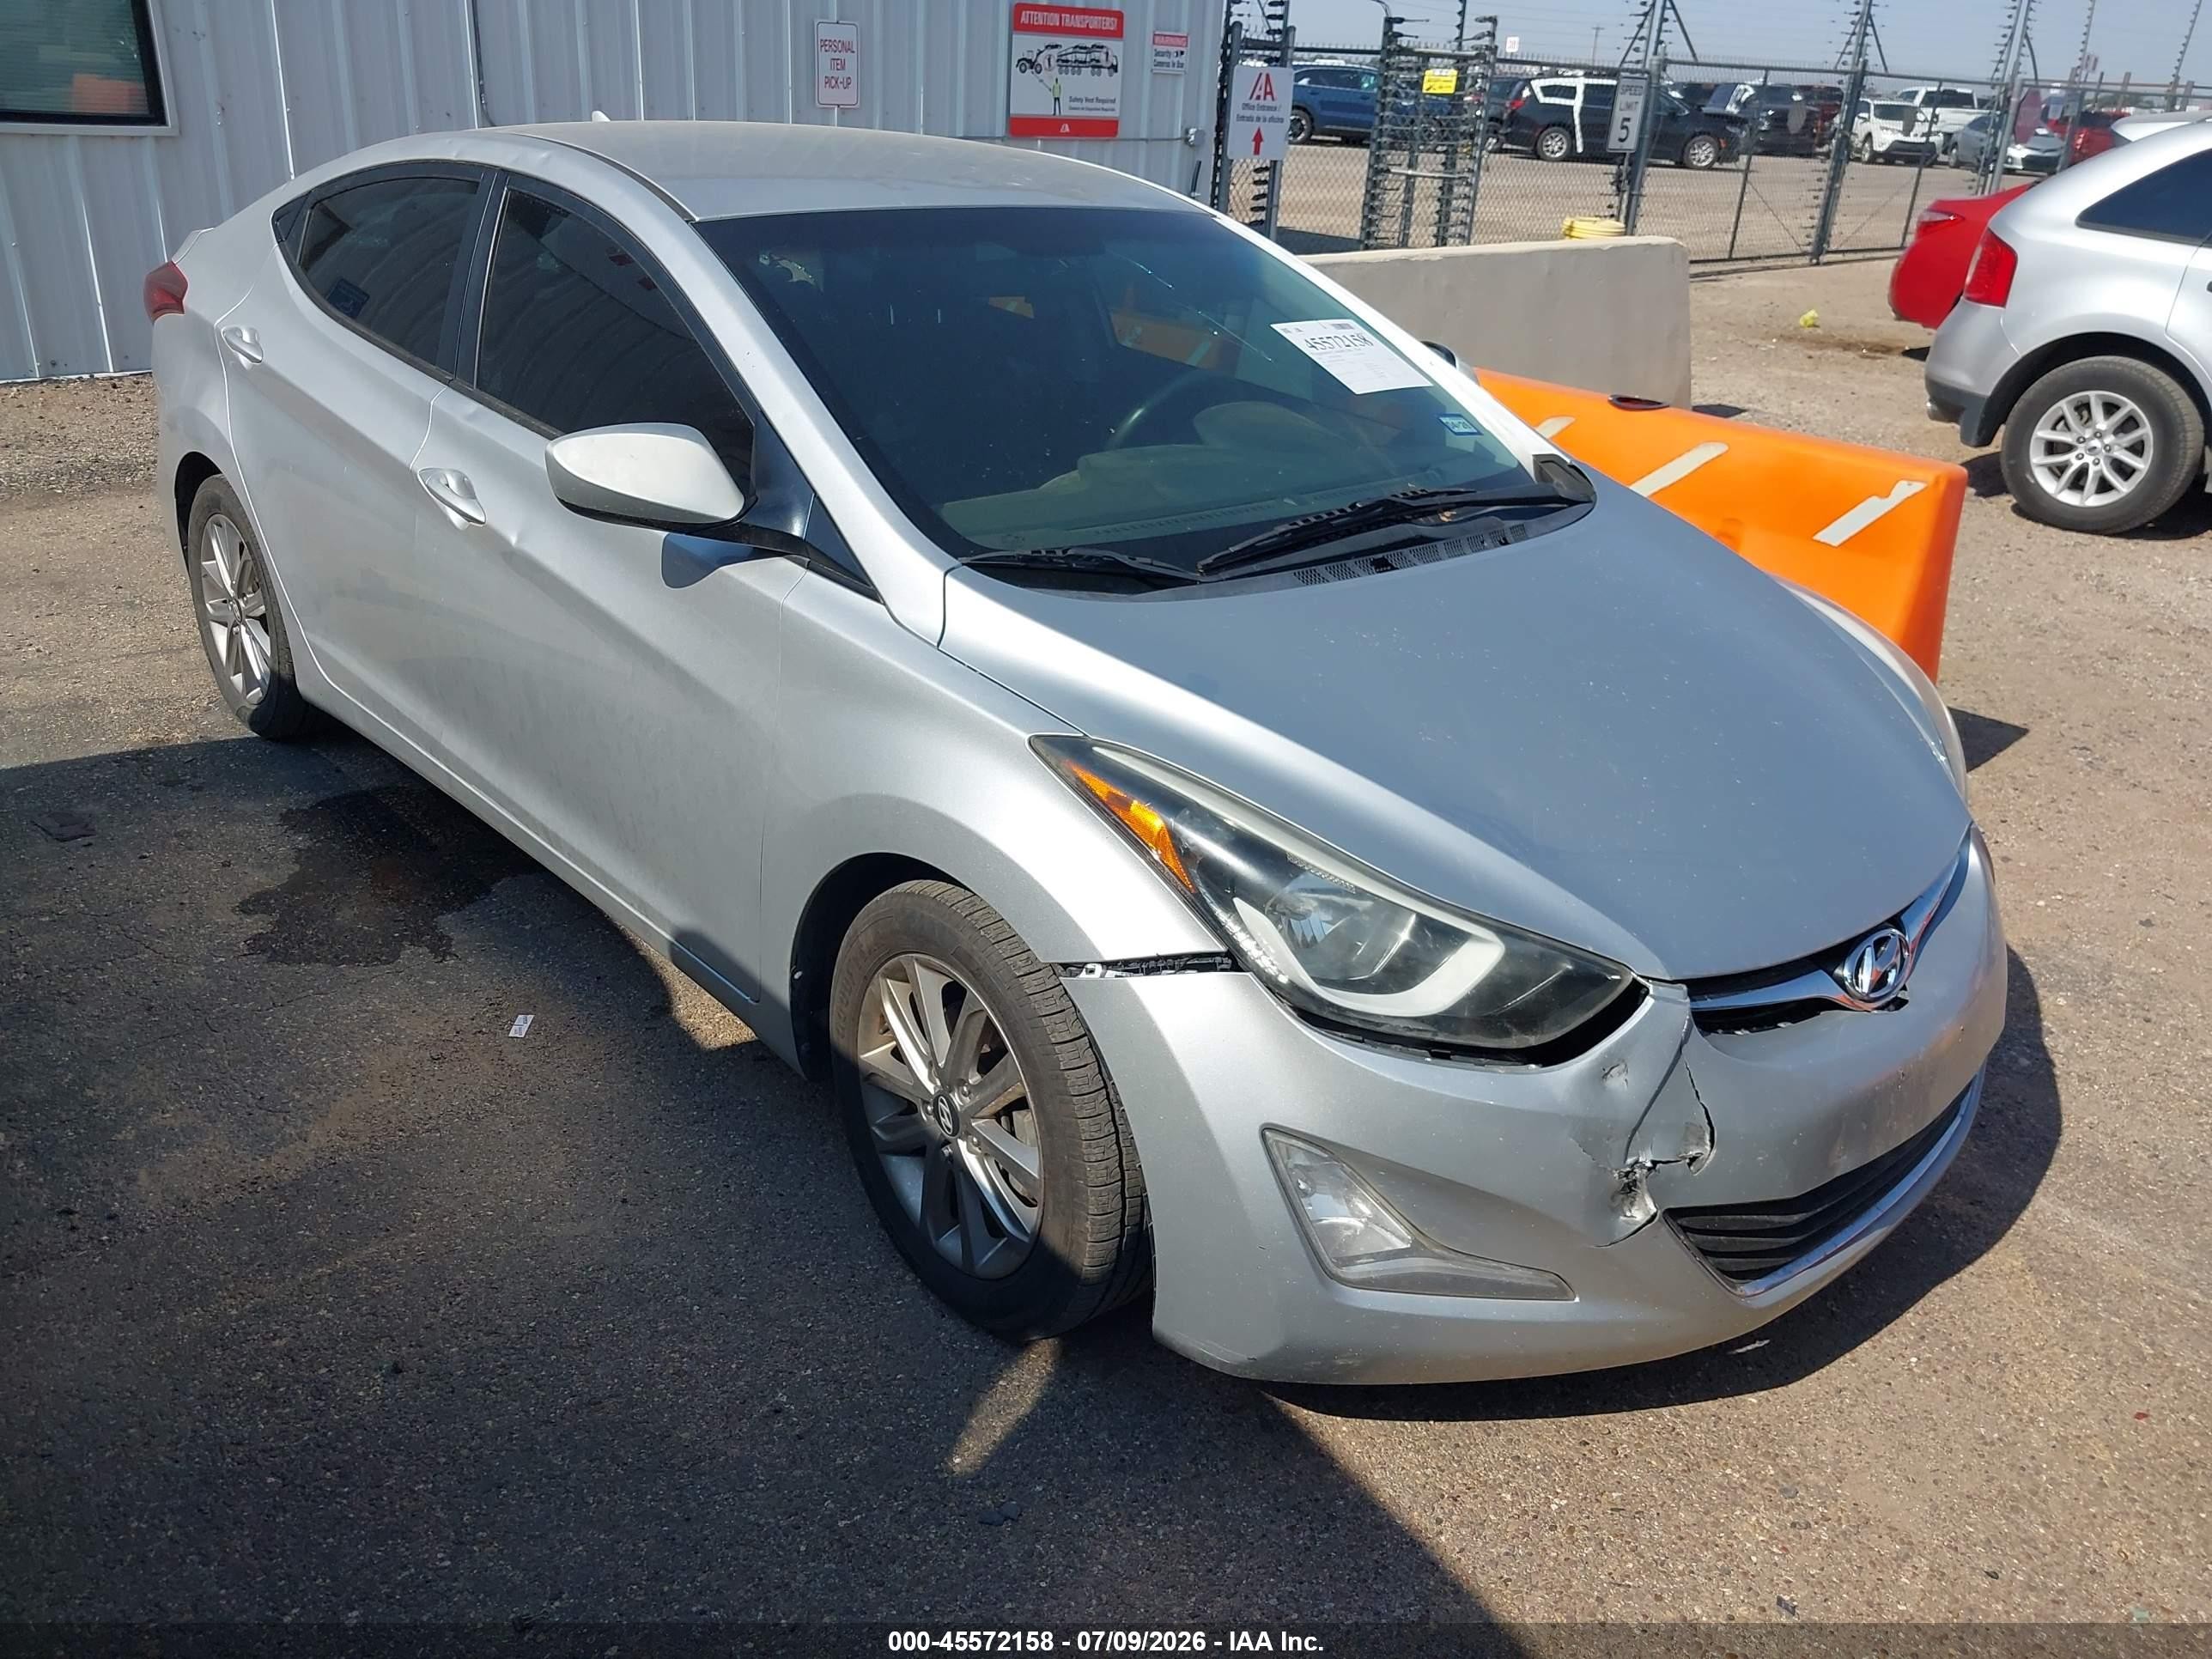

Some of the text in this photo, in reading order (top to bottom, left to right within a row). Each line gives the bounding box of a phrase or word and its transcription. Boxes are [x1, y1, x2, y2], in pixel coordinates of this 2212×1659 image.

[1020, 10, 1060, 27] ATTENTION
[820, 39, 855, 53] PERSONAL
[830, 58, 846, 70] ITEM
[824, 76, 852, 89] PICK-UP
[1620, 84, 1644, 96] SPEED
[1069, 95, 1084, 104] Safety
[1095, 96, 1116, 105] Required
[1620, 100, 1638, 112] LIMIT
[1618, 118, 1632, 143] 5
[1304, 332, 1374, 351] 45572158
